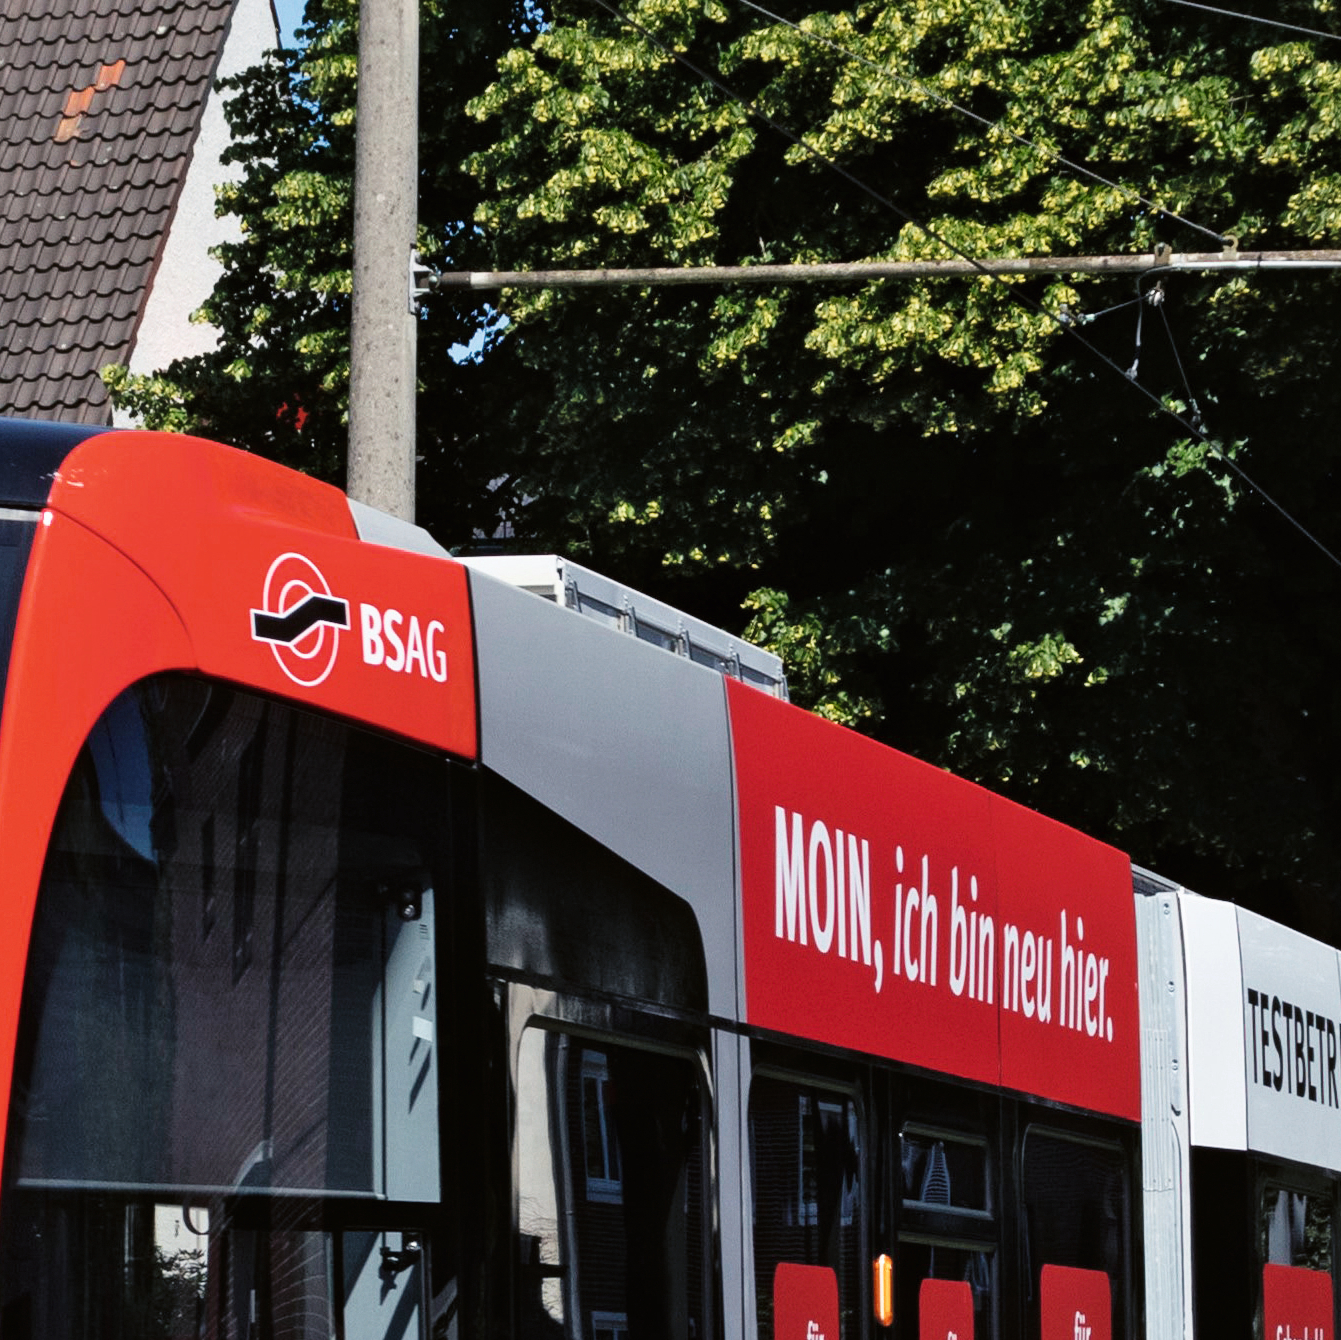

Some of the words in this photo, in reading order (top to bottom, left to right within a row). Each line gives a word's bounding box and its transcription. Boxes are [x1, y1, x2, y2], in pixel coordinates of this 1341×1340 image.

[360, 603, 447, 682] BSAG
[775, 805, 883, 993] MOIN,
[893, 845, 937, 986] ich
[949, 866, 994, 1005] bin
[1003, 922, 1052, 1024] neu
[1060, 909, 1113, 1042] hier.
